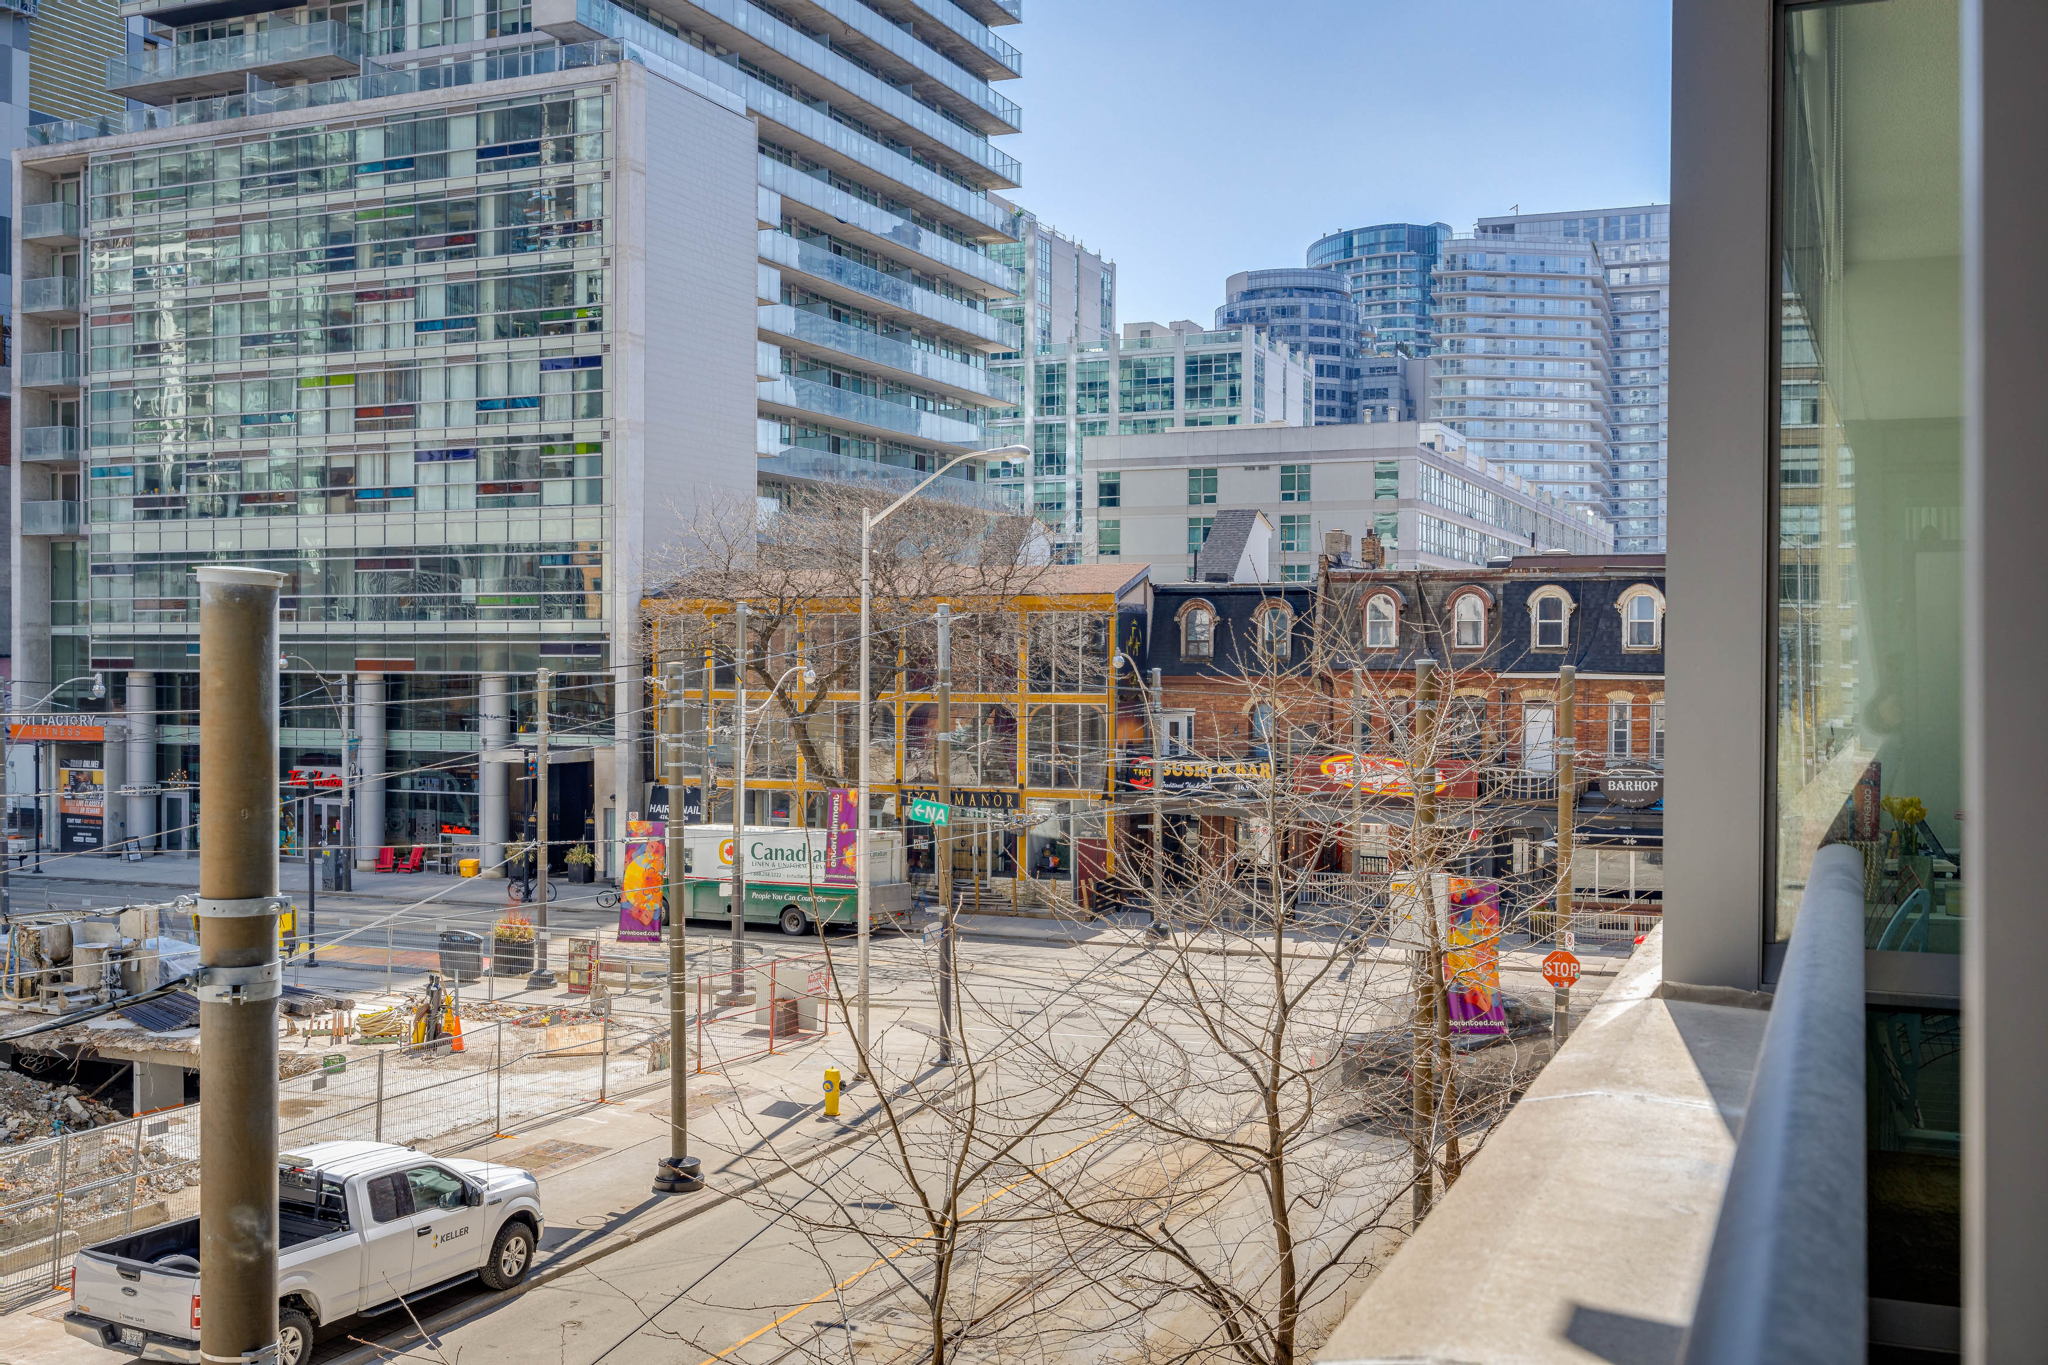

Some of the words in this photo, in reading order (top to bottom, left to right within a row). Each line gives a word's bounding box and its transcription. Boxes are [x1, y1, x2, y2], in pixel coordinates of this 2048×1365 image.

[42, 715, 95, 726] FACTORY
[32, 727, 81, 737] FITNESS
[288, 770, 309, 786] Tim
[312, 769, 343, 787] Horton
[1607, 780, 1659, 792] BARHOP
[954, 793, 1014, 807] MANOR
[649, 804, 670, 813] HAIR
[925, 807, 945, 822] NA
[751, 841, 827, 863] Canada
[751, 891, 771, 901] People
[784, 894, 796, 902] Can
[797, 895, 815, 903] Coun
[1543, 961, 1580, 977] STOP
[440, 1226, 469, 1243] KELLER
